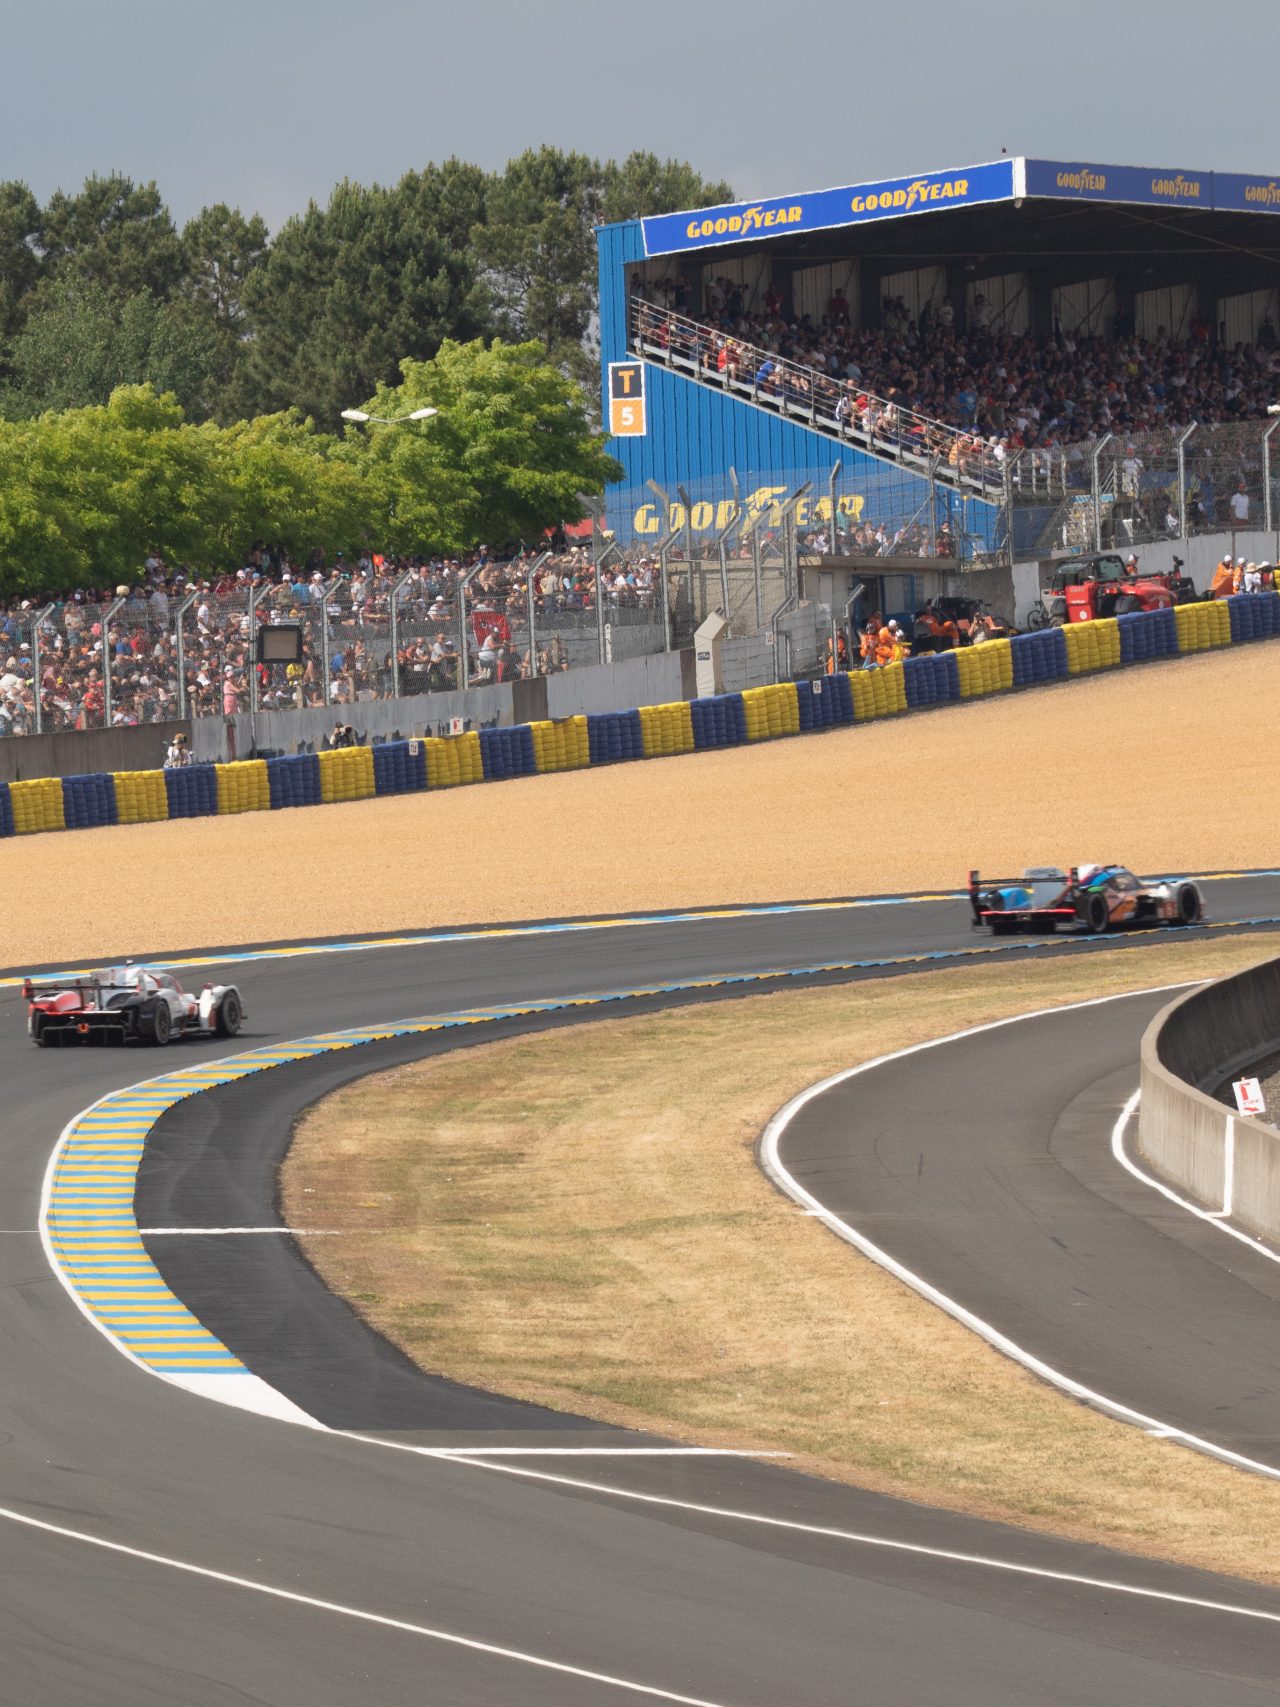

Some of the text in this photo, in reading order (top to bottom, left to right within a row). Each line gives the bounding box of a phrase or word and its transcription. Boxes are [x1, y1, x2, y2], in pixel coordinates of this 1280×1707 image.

[1057, 169, 1106, 193] GOODYEAR
[1151, 175, 1200, 199] GOODYEAR
[851, 180, 968, 212] GOODYEAR
[687, 206, 802, 238] GOODYEAR
[618, 370, 635, 393] T
[621, 407, 634, 426] 5
